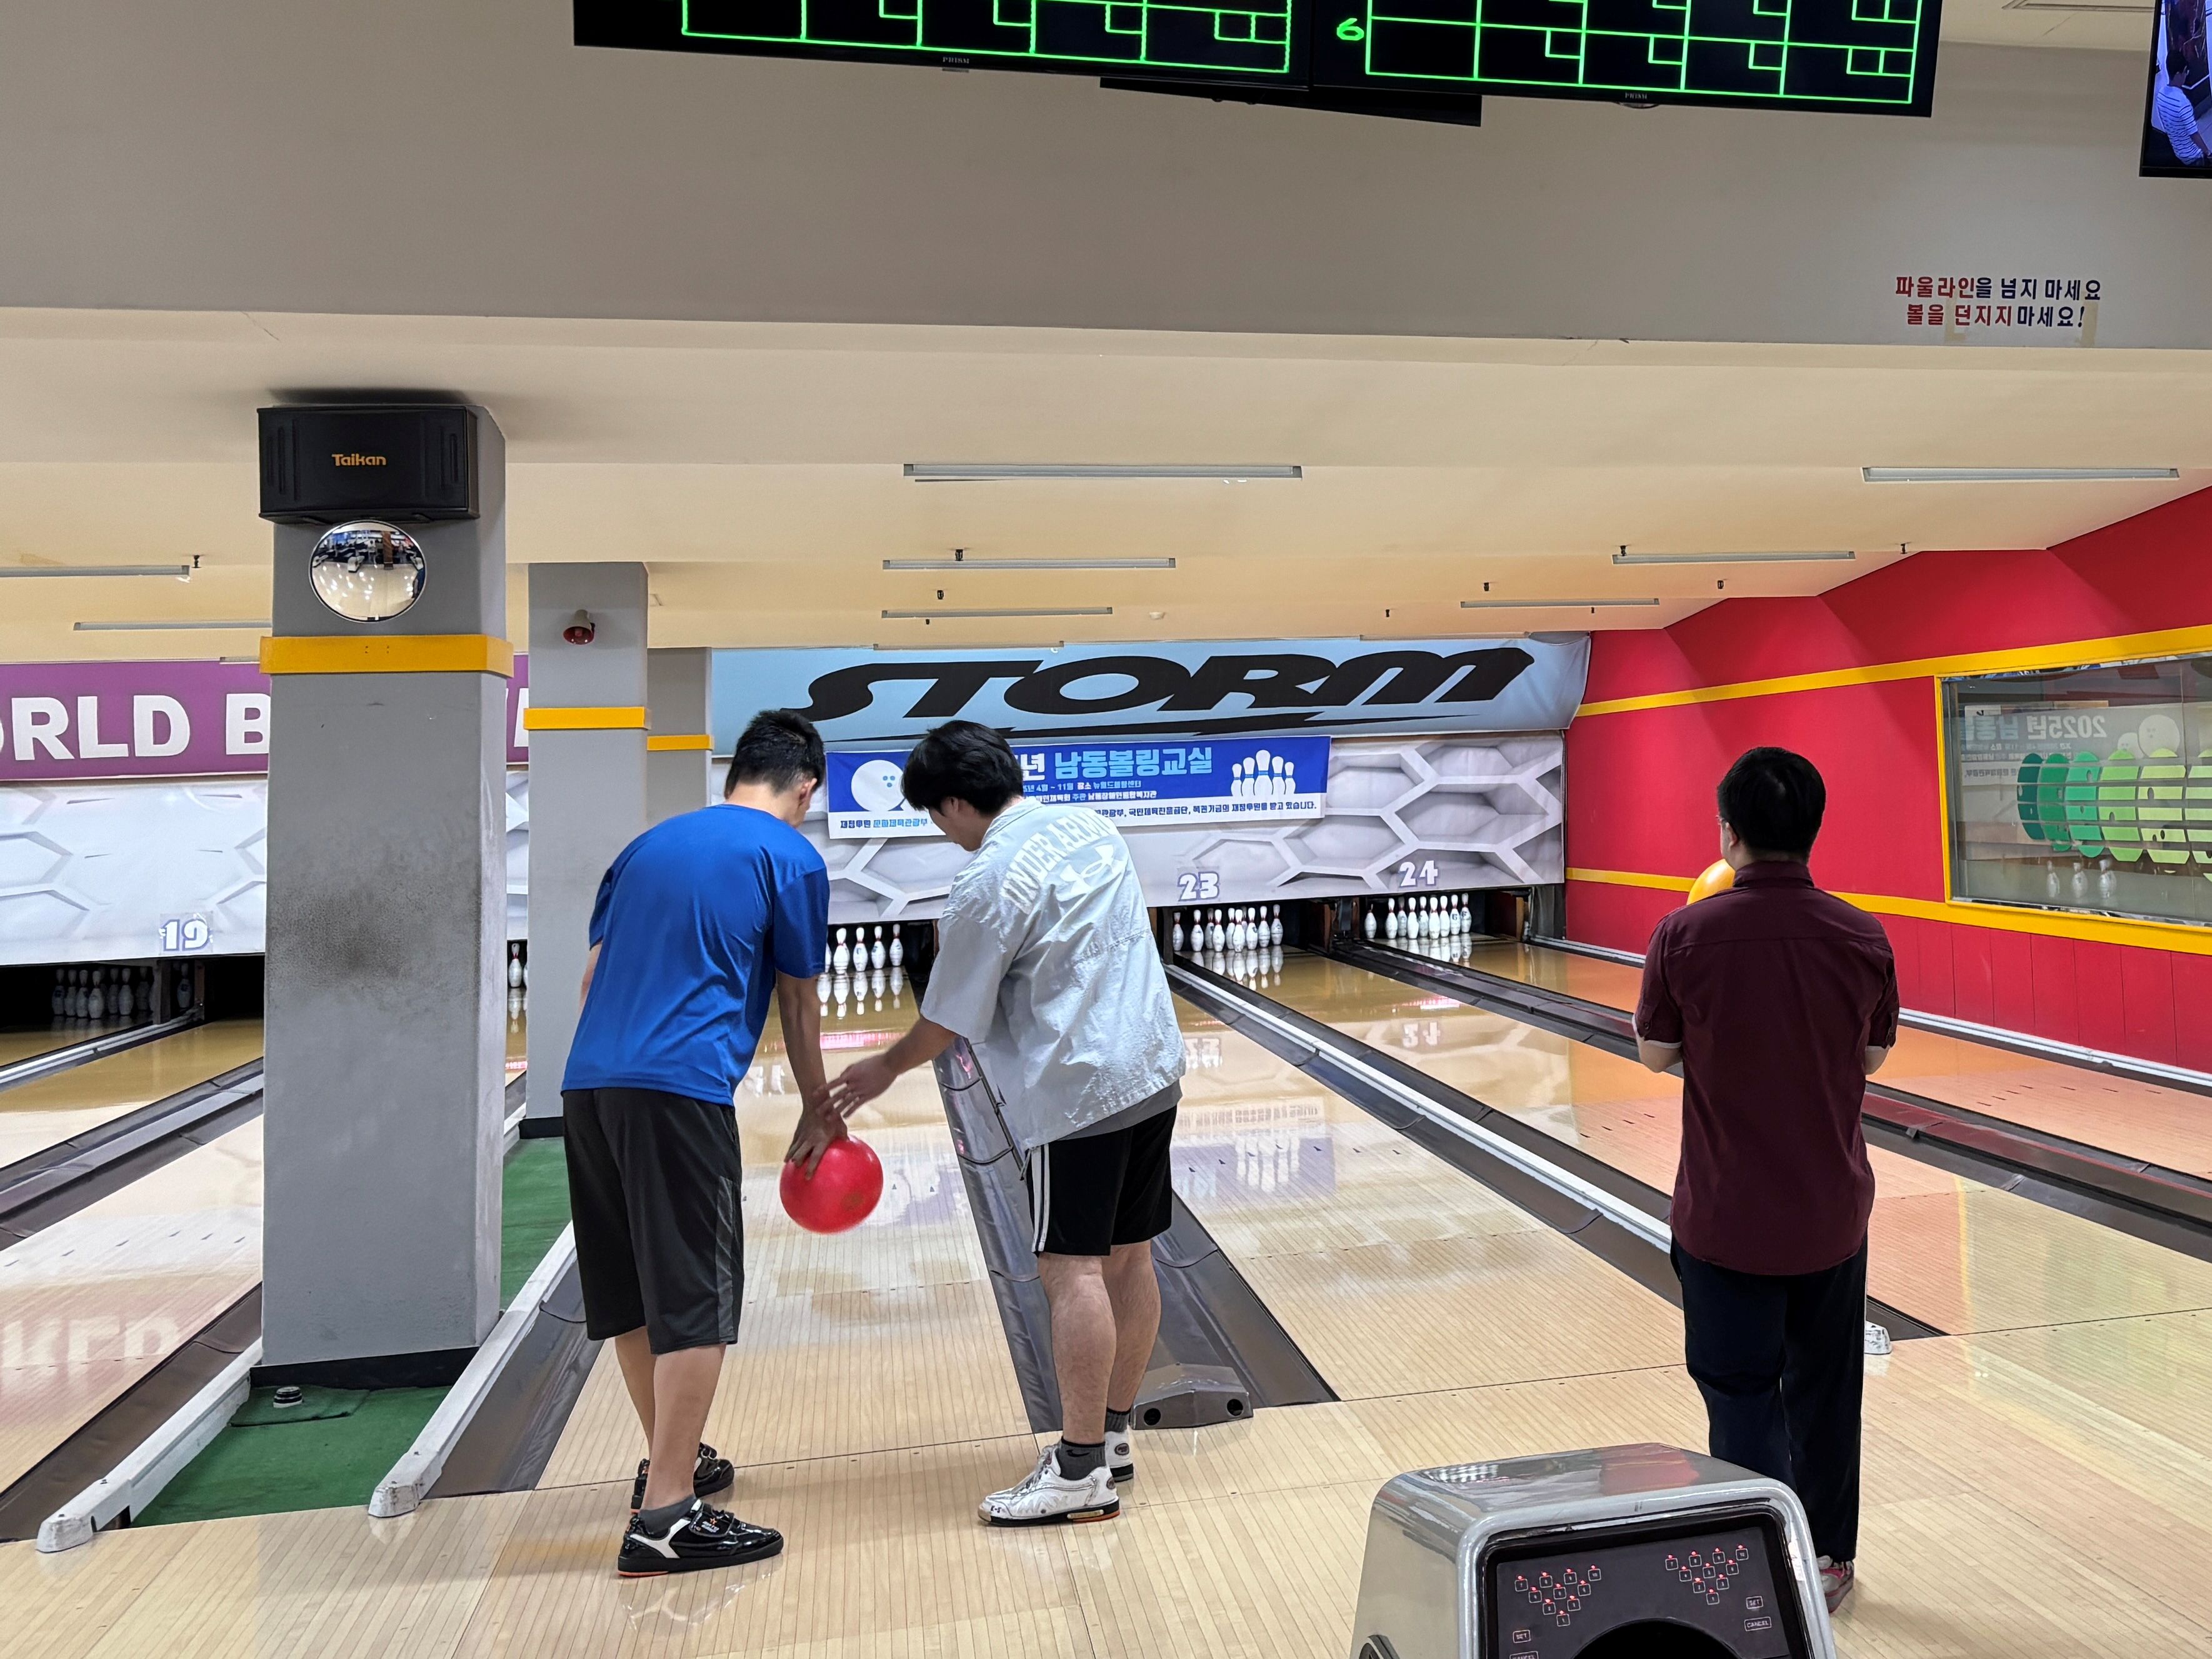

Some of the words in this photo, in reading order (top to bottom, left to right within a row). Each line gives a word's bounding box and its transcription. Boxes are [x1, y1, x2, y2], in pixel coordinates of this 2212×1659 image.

[1336, 18, 1364, 41] 6
[1895, 276, 1993, 299] 파울라인을
[2001, 278, 2038, 299] 넘지
[2044, 279, 2101, 301] 마세요
[1906, 304, 1944, 326] 볼을
[1954, 304, 2013, 326] 던지지
[2016, 306, 2085, 328] 마세요!
[331, 453, 387, 466] Taikan
[780, 648, 1534, 723] STORM
[0, 694, 191, 760] RLD
[1015, 753, 1045, 781] 년
[1054, 747, 1213, 780] 남동볼링교실
[999, 832, 1068, 915] UNDER
[1046, 811, 1118, 855] ARMO
[1398, 860, 1439, 887] 24
[1177, 870, 1220, 902] 23
[160, 918, 211, 951] 19
